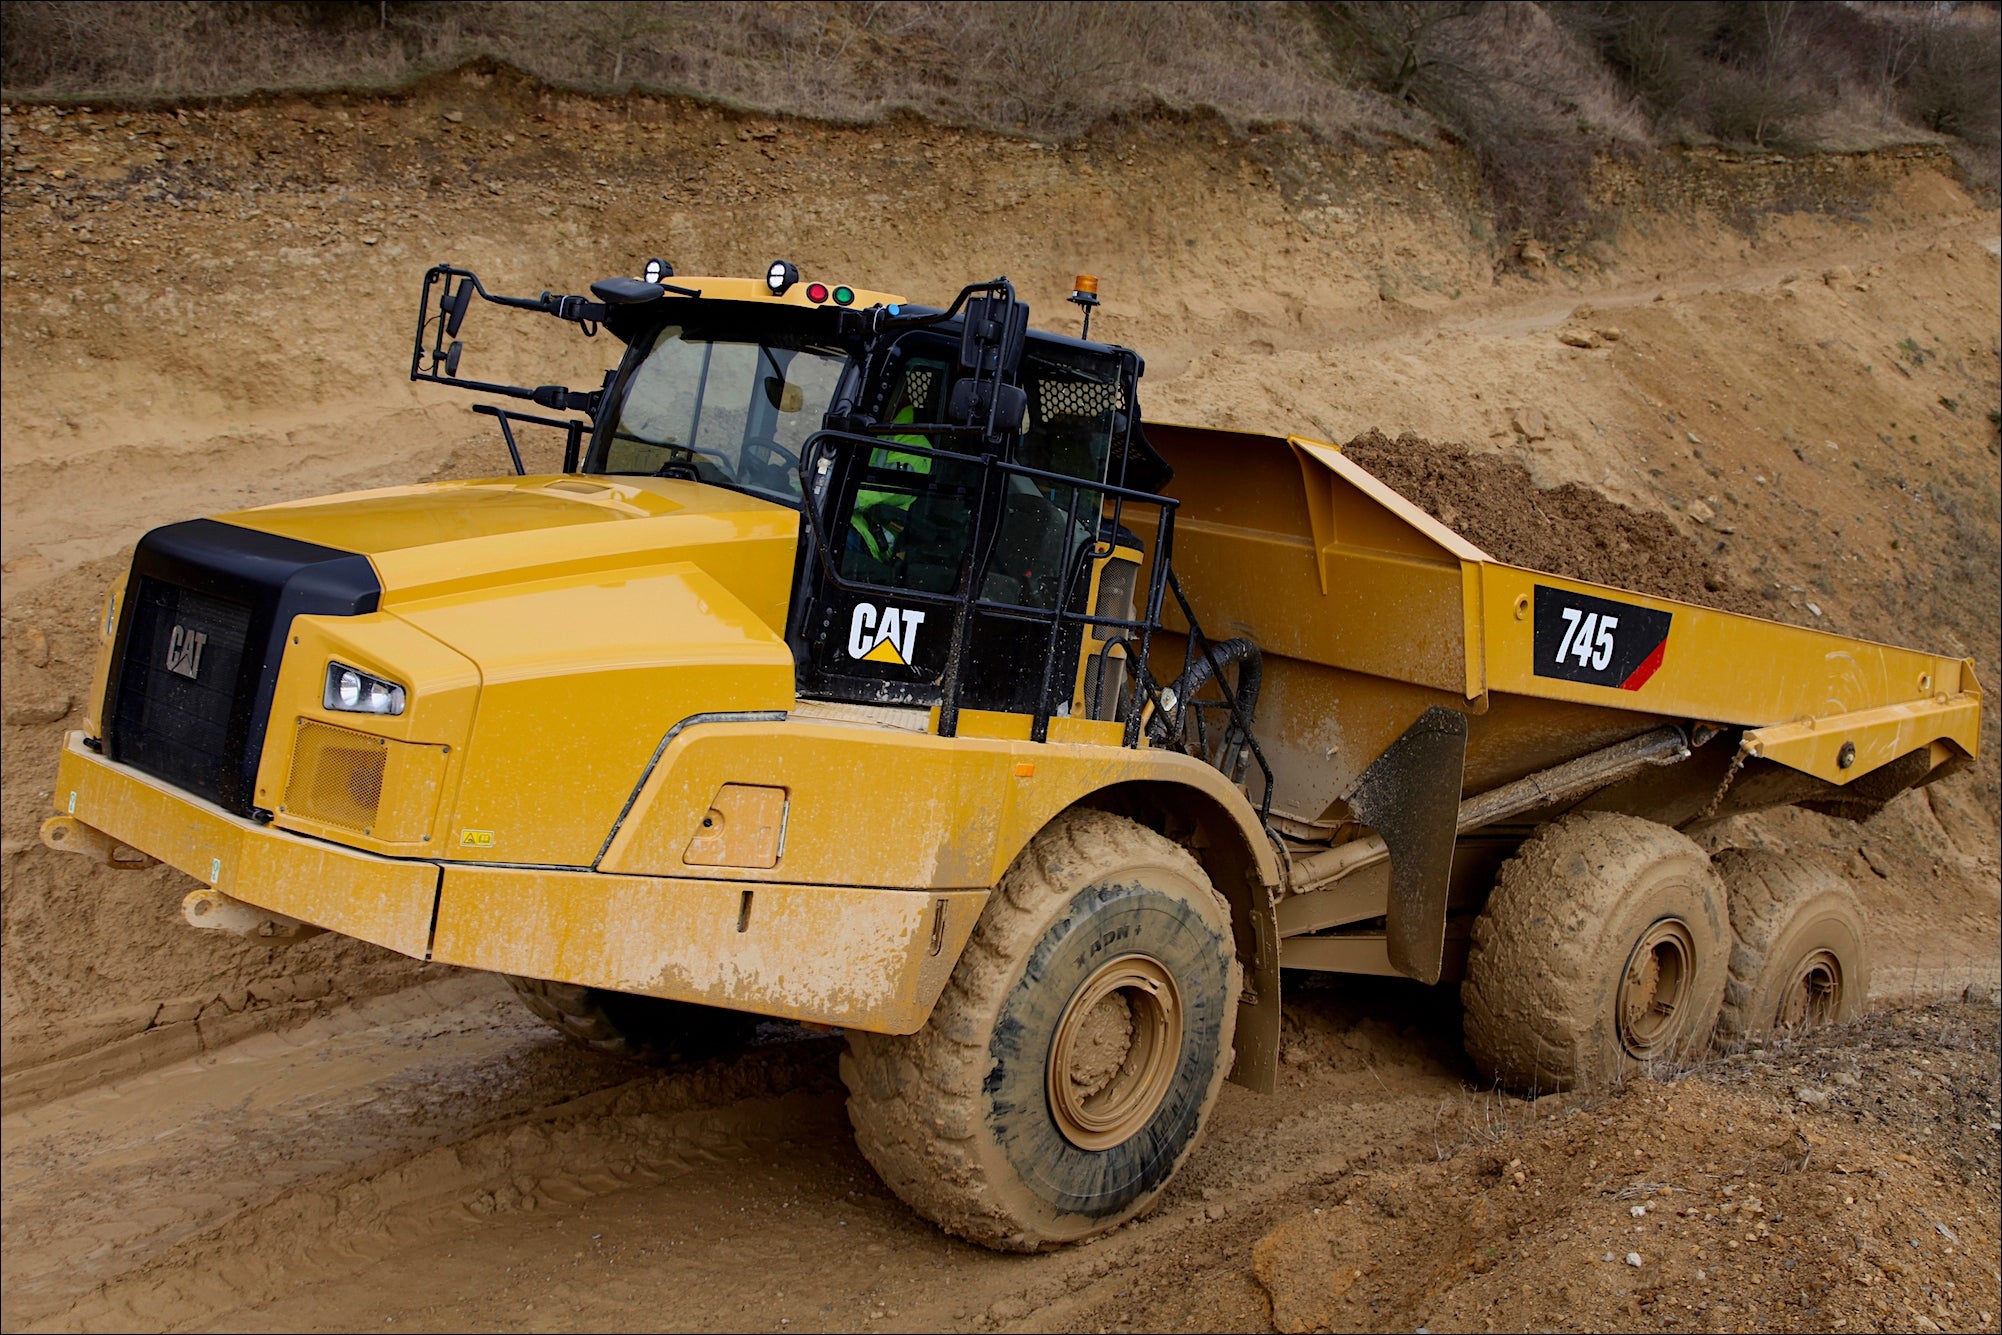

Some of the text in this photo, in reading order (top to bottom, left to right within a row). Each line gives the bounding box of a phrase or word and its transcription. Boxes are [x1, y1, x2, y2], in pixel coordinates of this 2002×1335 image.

[166, 624, 208, 680] CAT
[848, 602, 925, 666] CAT
[1555, 607, 1619, 671] 745
